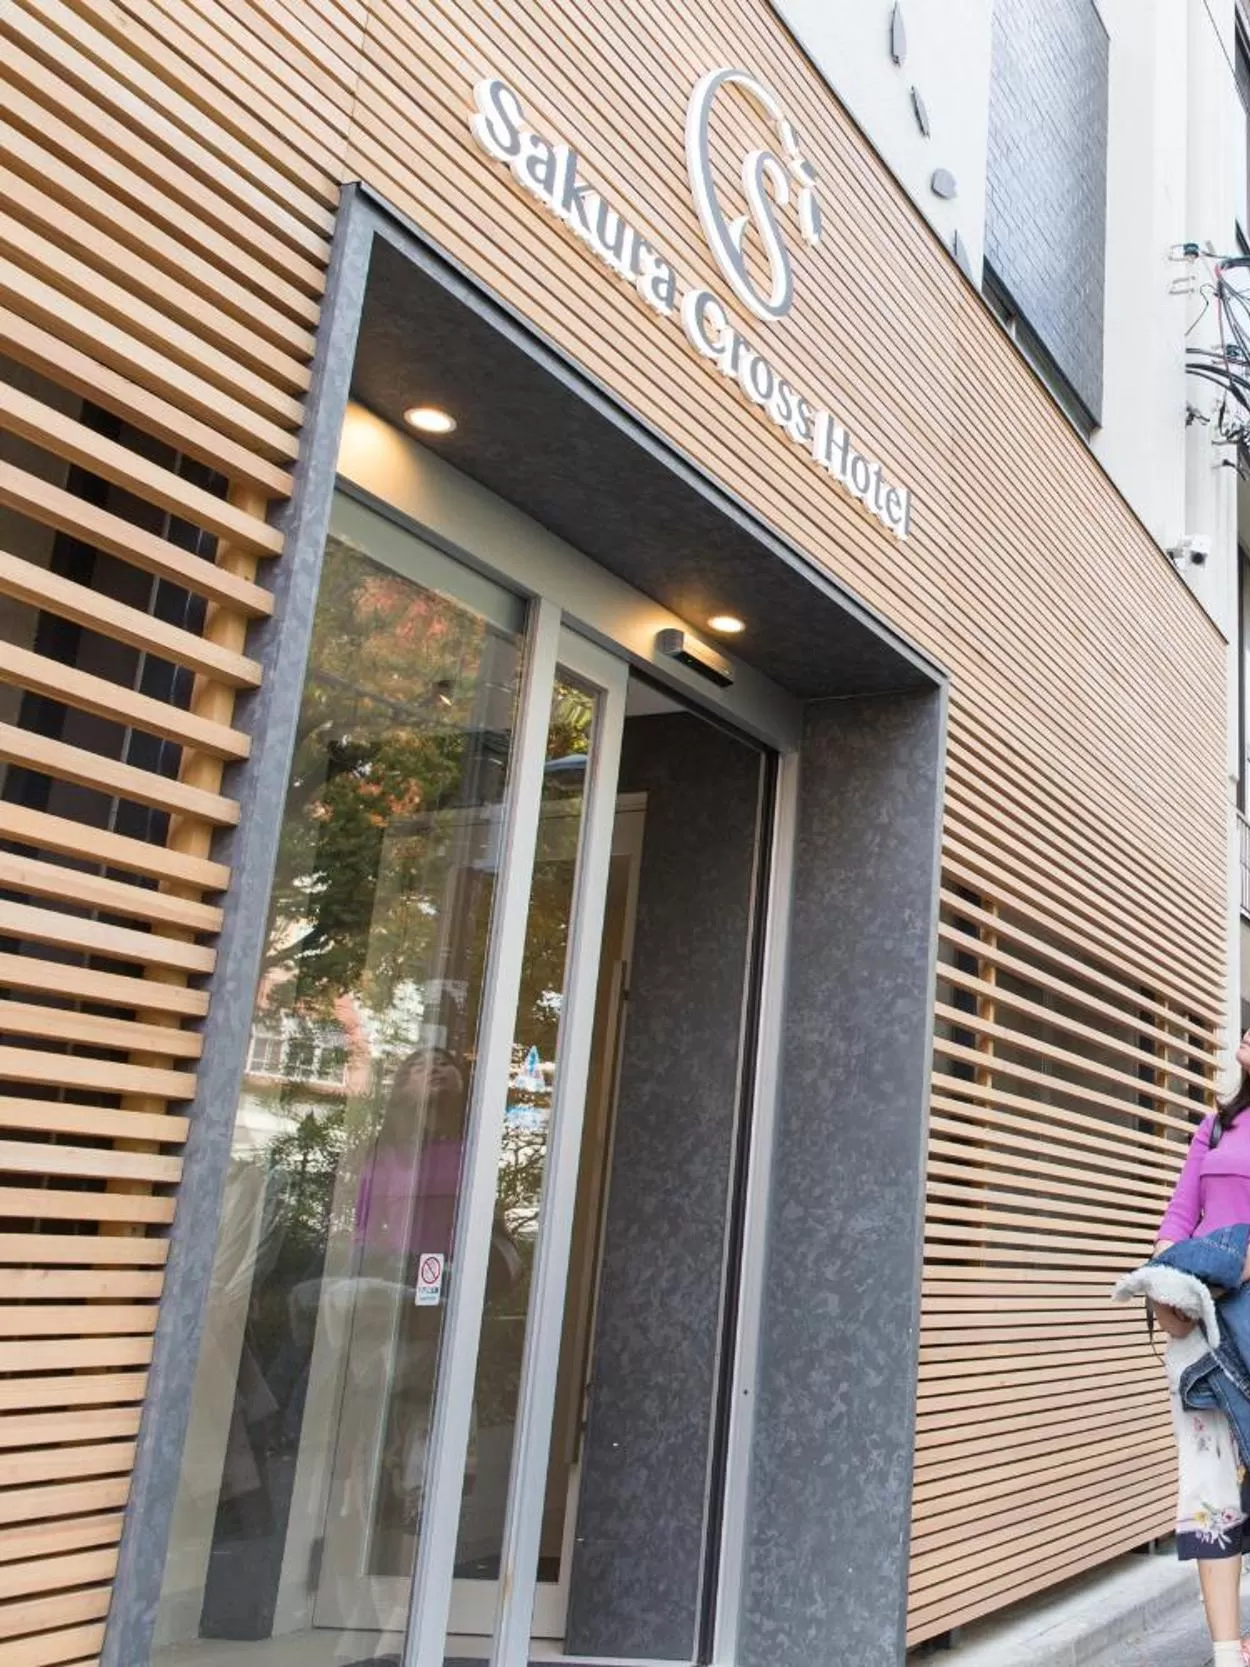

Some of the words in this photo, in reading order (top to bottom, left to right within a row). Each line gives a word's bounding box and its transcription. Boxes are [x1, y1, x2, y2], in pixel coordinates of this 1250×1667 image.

[469, 77, 677, 317] Sakura
[681, 289, 814, 443] Cross
[813, 409, 914, 540] Hotel
